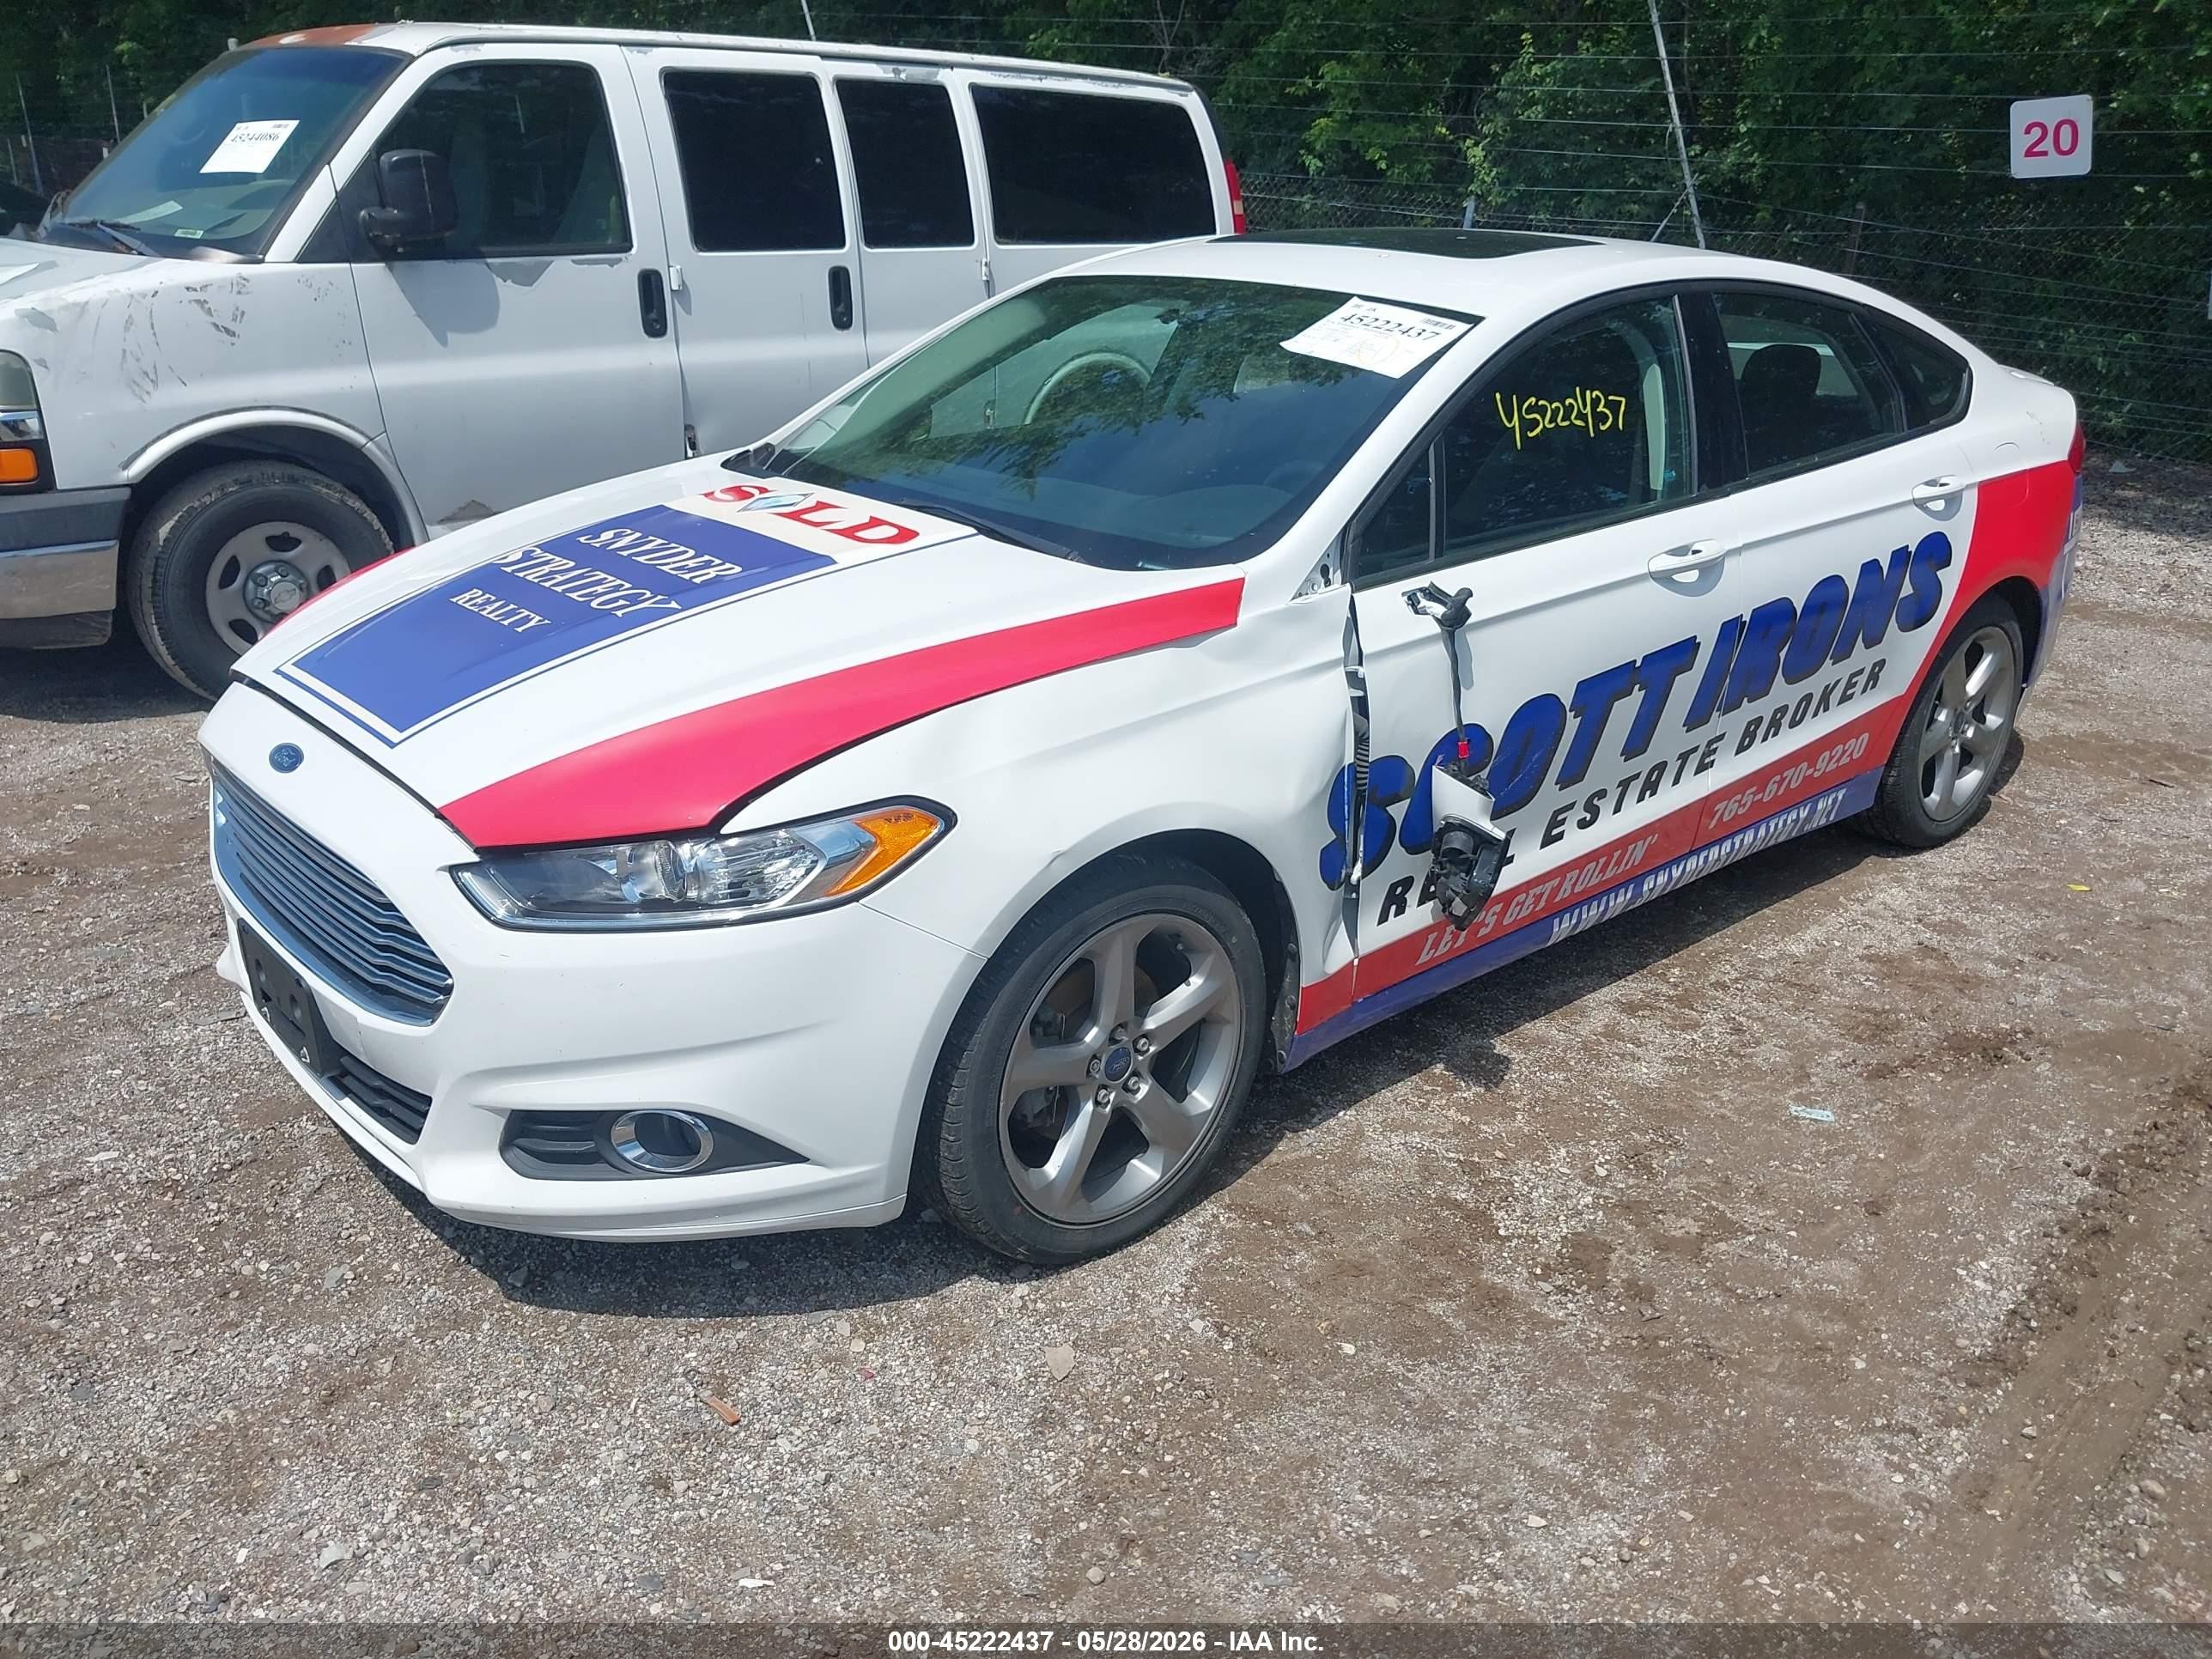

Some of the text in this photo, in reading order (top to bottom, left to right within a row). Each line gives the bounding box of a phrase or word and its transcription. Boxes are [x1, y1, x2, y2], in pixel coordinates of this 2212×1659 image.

[2024, 118, 2079, 158] 20
[1340, 313, 1442, 341] 45222437
[1495, 386, 1626, 450] 45222437
[490, 544, 683, 617] STRATEGY
[576, 528, 743, 584] SNYDER
[449, 588, 551, 633] REALTY
[1682, 531, 1954, 732] IRONS
[1540, 732, 1727, 850] ESTATE
[1735, 658, 1887, 758] BROKER
[1709, 732, 1869, 830] 765-670-9220
[1503, 877, 1559, 926] GET
[1555, 833, 1659, 902] ROLLIN'
